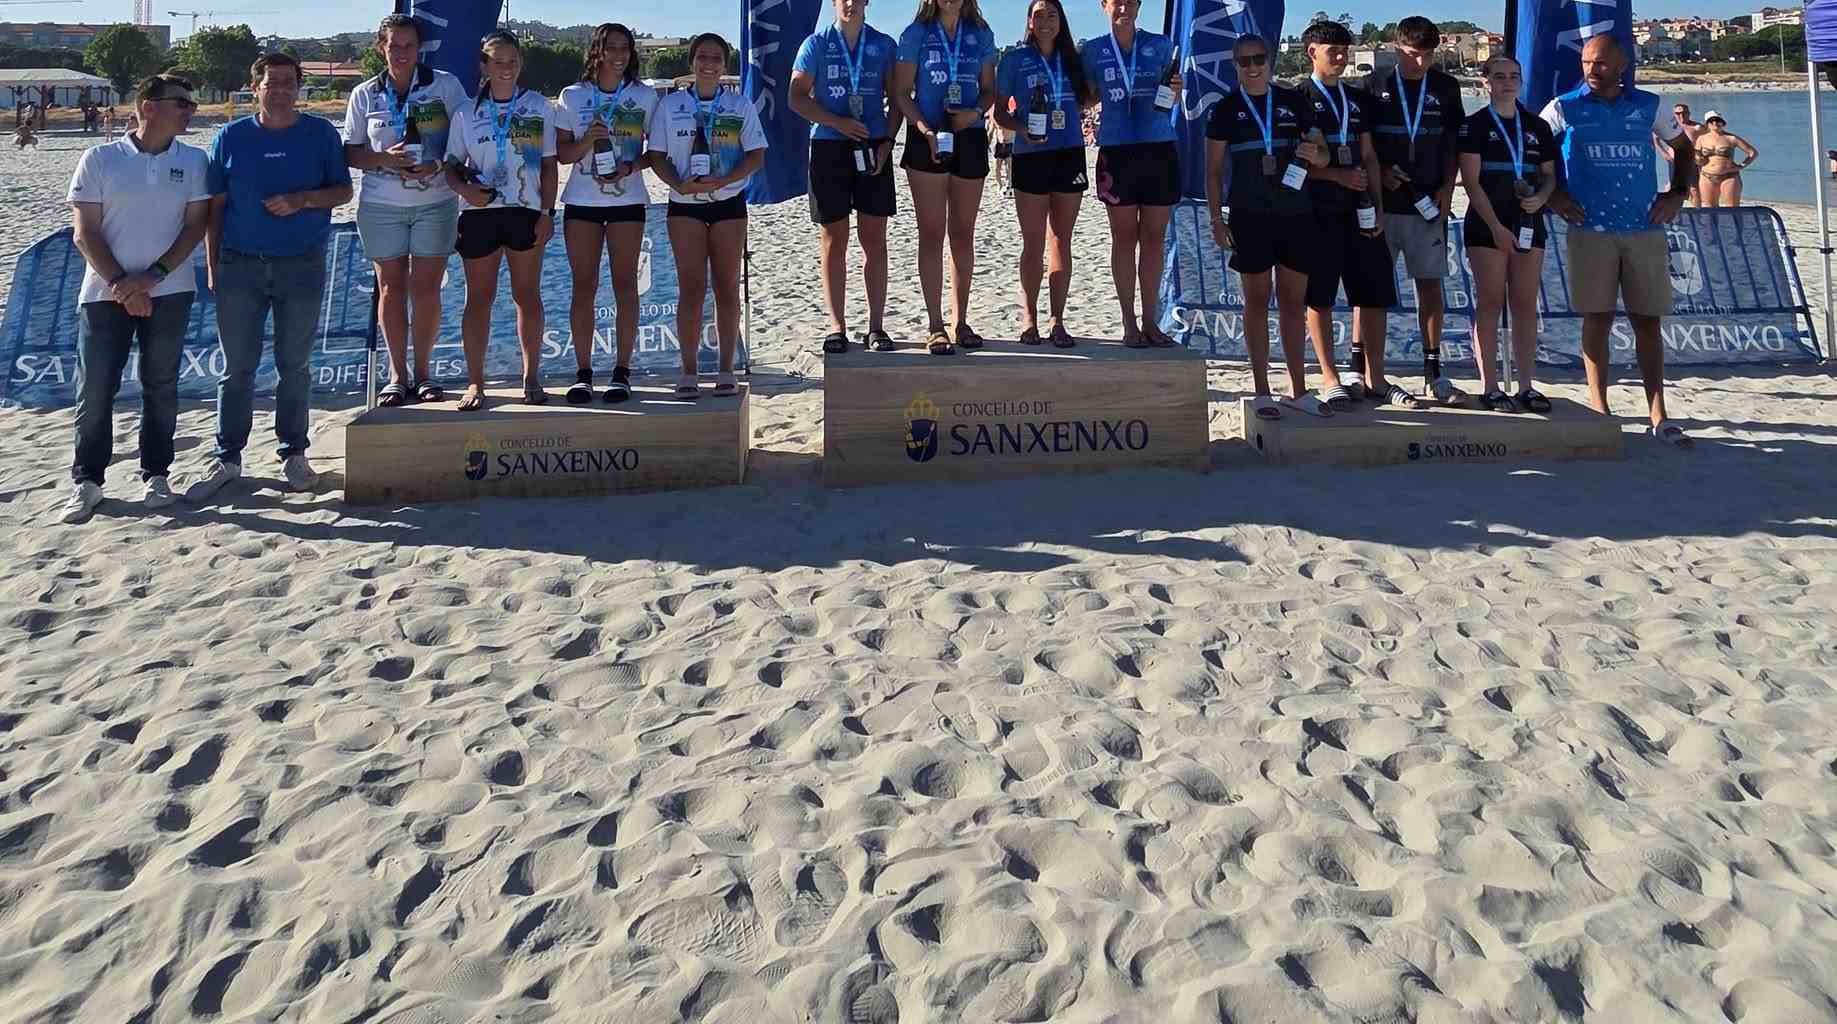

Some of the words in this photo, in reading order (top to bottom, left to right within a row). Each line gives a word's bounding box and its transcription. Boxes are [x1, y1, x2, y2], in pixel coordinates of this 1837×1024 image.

[1612, 322, 1786, 352] SNXENXO
[952, 400, 1030, 418] CONCELLO
[1033, 400, 1055, 416] DE
[500, 437, 556, 450] CONCELLO
[558, 435, 574, 448] DE
[950, 418, 1150, 457] SANXENXO
[1425, 442, 1507, 458] SANXENXO
[496, 448, 640, 477] SANXENXO
